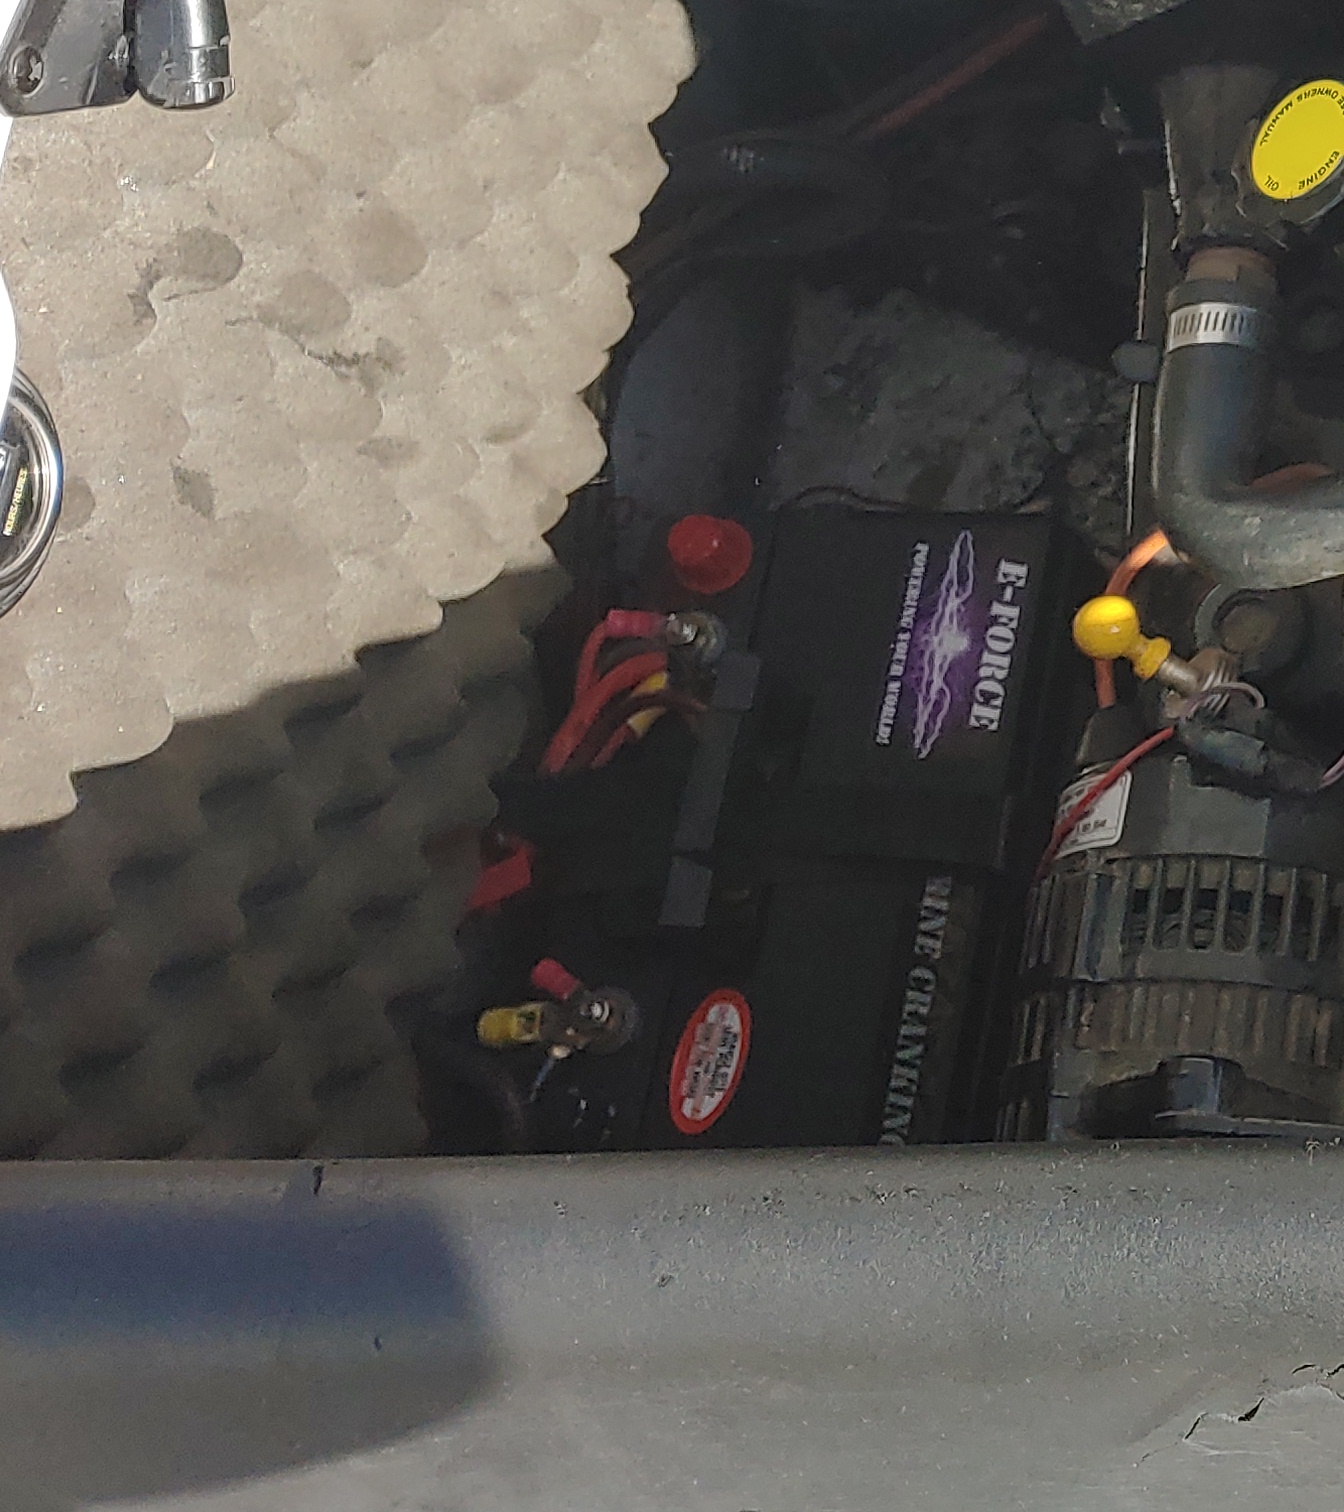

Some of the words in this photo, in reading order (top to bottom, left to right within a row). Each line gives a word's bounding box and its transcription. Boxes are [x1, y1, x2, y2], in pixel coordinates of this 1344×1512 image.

[1259, 100, 1294, 148] MANUAL
[1264, 174, 1280, 191] OIL
[1298, 150, 1341, 191] ENGINE
[969, 557, 1029, 732] E-FORCE
